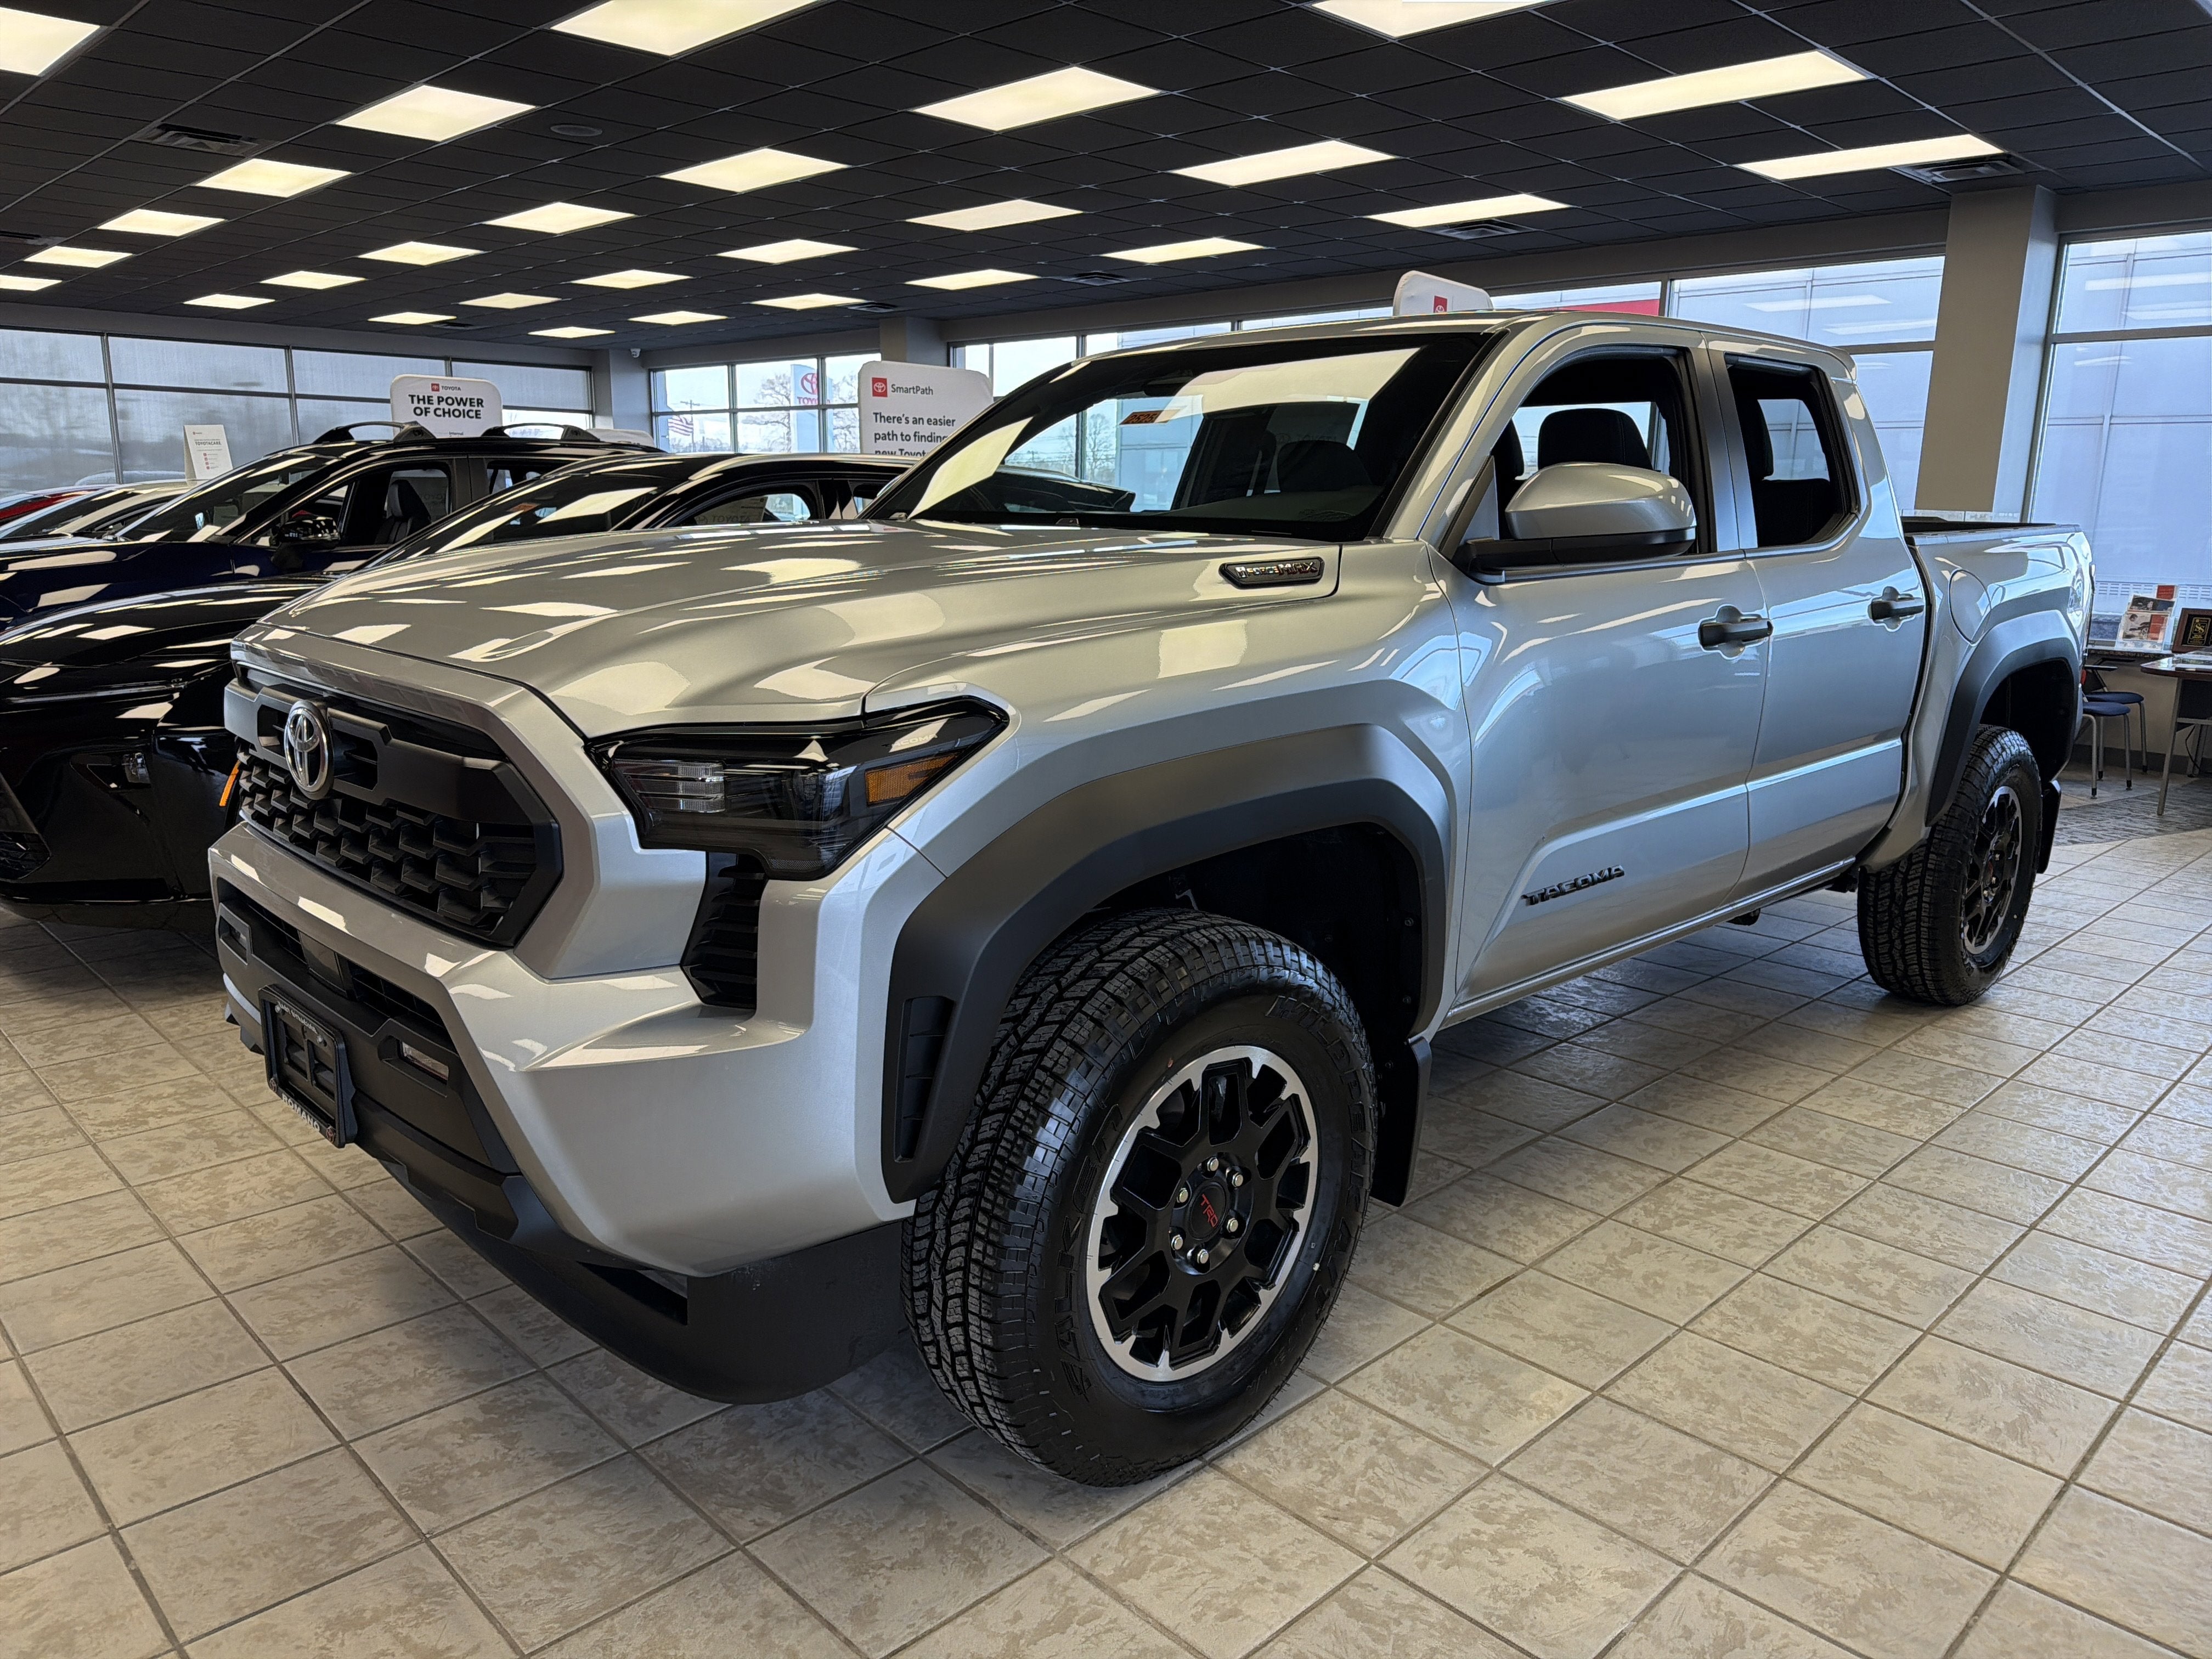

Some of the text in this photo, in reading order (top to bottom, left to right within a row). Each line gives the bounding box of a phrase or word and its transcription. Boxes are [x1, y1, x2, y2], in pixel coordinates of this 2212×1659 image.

[891, 384, 933, 395] SmartPath
[408, 394, 484, 408] THE POWER
[413, 407, 482, 419] OF CHOICE
[873, 412, 956, 427] There's an easier
[874, 430, 898, 443] path
[900, 432, 911, 442] to
[899, 448, 926, 456] Toyot
[1521, 865, 1625, 906] TACOMA
[281, 1093, 320, 1132] ROMANO
[1200, 1194, 1218, 1228] TRD
